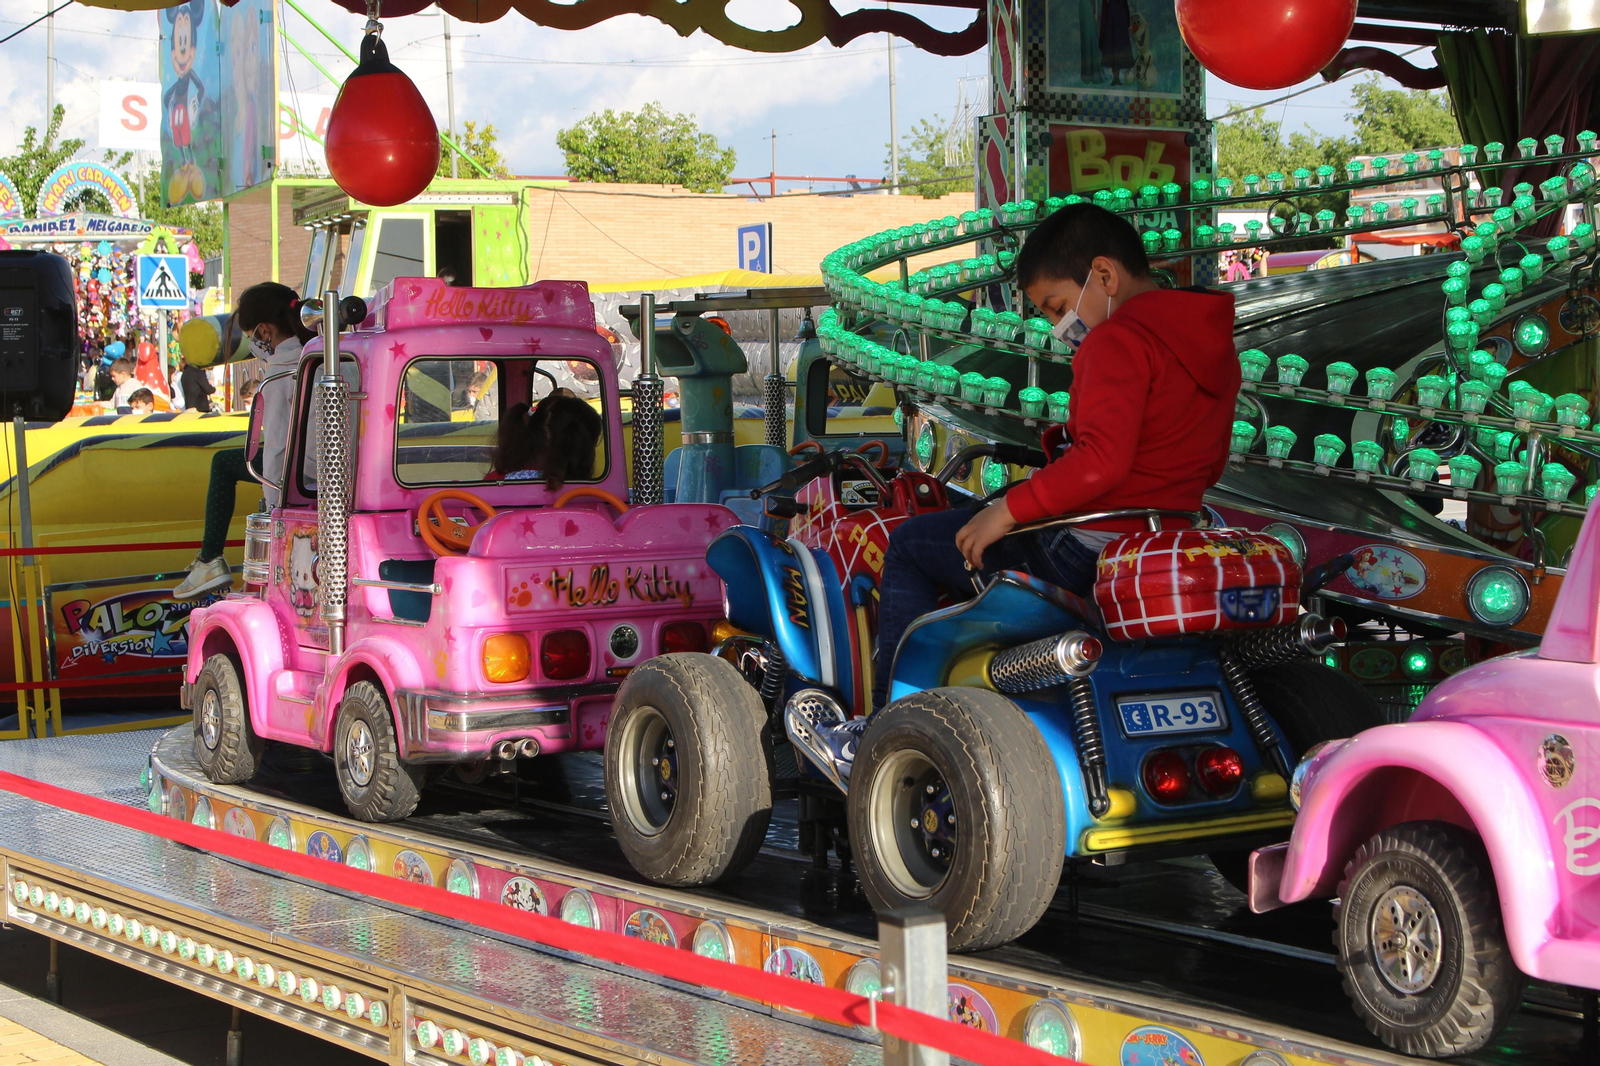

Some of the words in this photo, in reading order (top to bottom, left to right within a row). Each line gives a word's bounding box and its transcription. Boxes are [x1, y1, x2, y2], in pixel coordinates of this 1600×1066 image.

[1065, 128, 1176, 198] Bob
[43, 169, 76, 212] MARI
[77, 166, 132, 212] CARMEN
[9, 218, 77, 233] RAMIREZ
[86, 218, 152, 233] MELGAREJO
[742, 231, 761, 271] P
[425, 287, 474, 319] Hello
[476, 289, 538, 325] Kitty
[546, 562, 620, 607] Hello
[624, 563, 696, 609] Kitty
[782, 565, 810, 629] MAN
[61, 598, 164, 635] PALO
[1151, 700, 1218, 728] R-93
